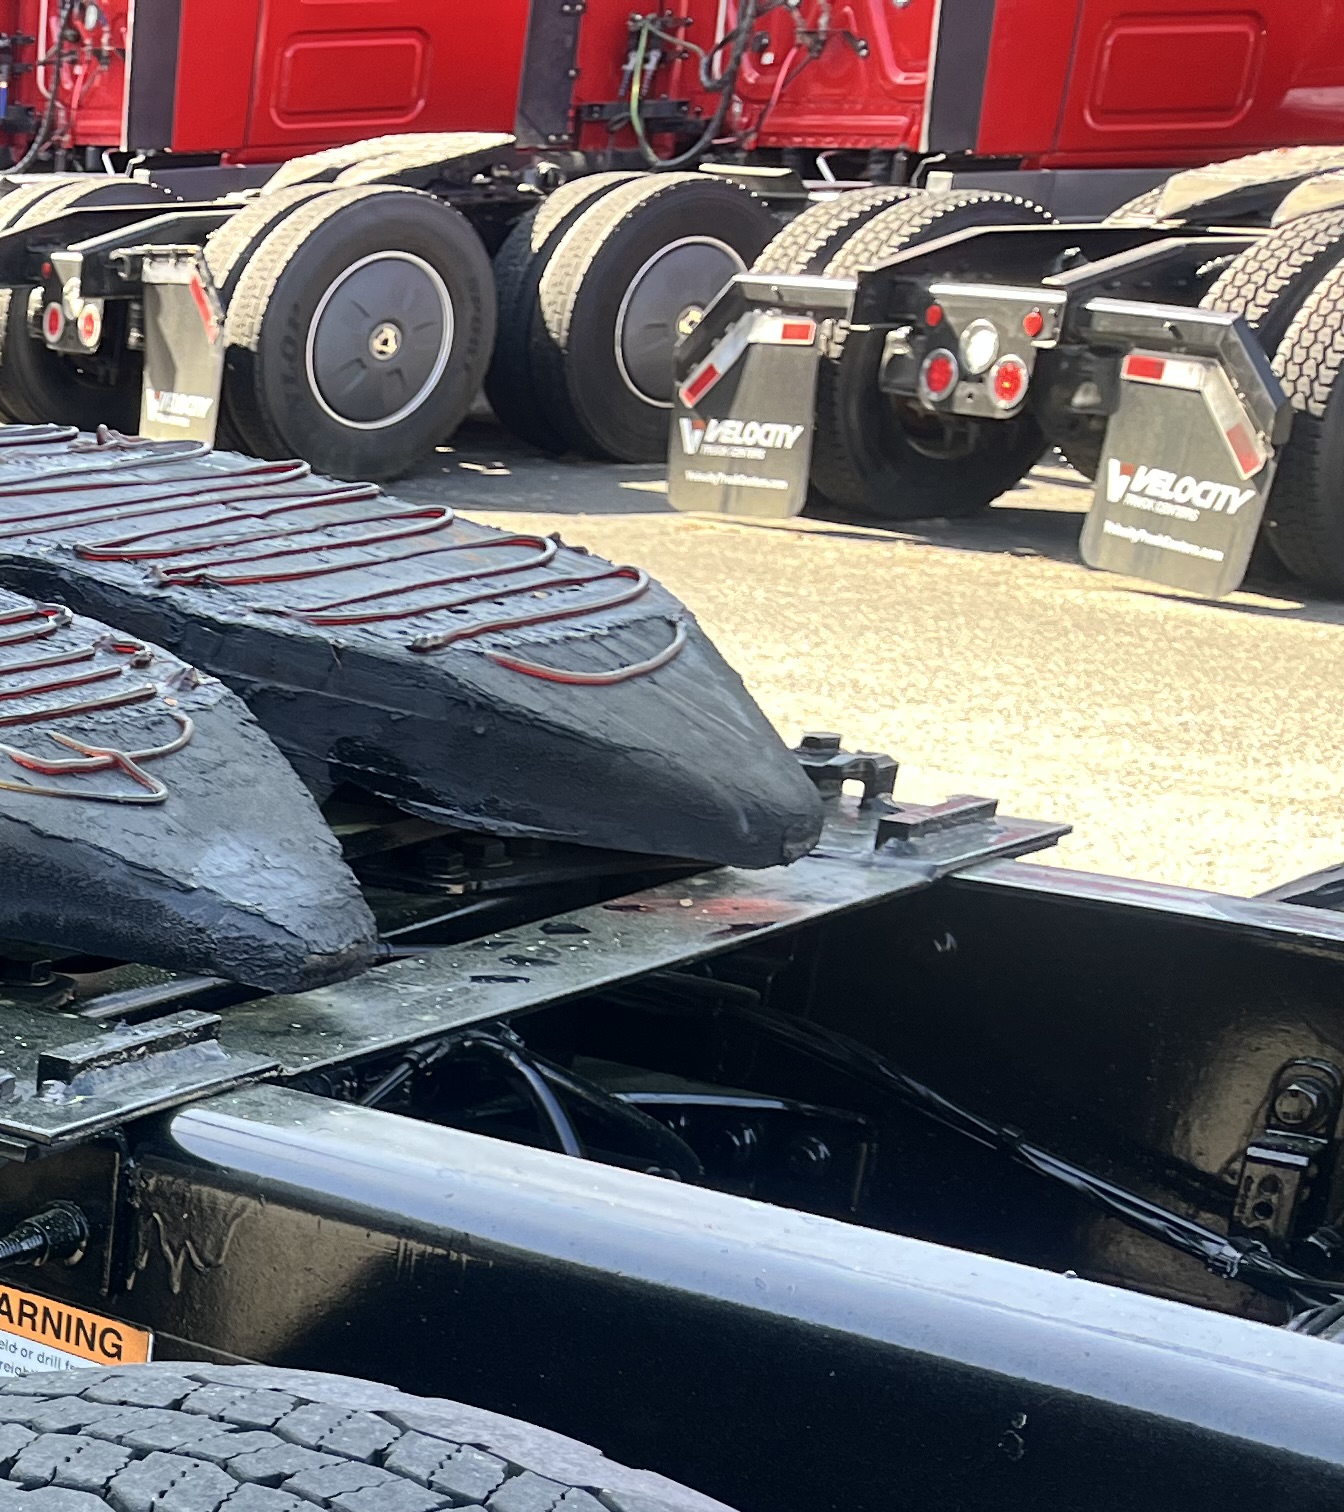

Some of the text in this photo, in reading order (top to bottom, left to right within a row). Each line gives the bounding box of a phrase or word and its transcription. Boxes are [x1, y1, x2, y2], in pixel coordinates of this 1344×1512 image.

[704, 418, 804, 449] VELOCITY
[1129, 465, 1256, 515] VELOCITY
[20, 1346, 34, 1359] or
[37, 1352, 61, 1370] drill
